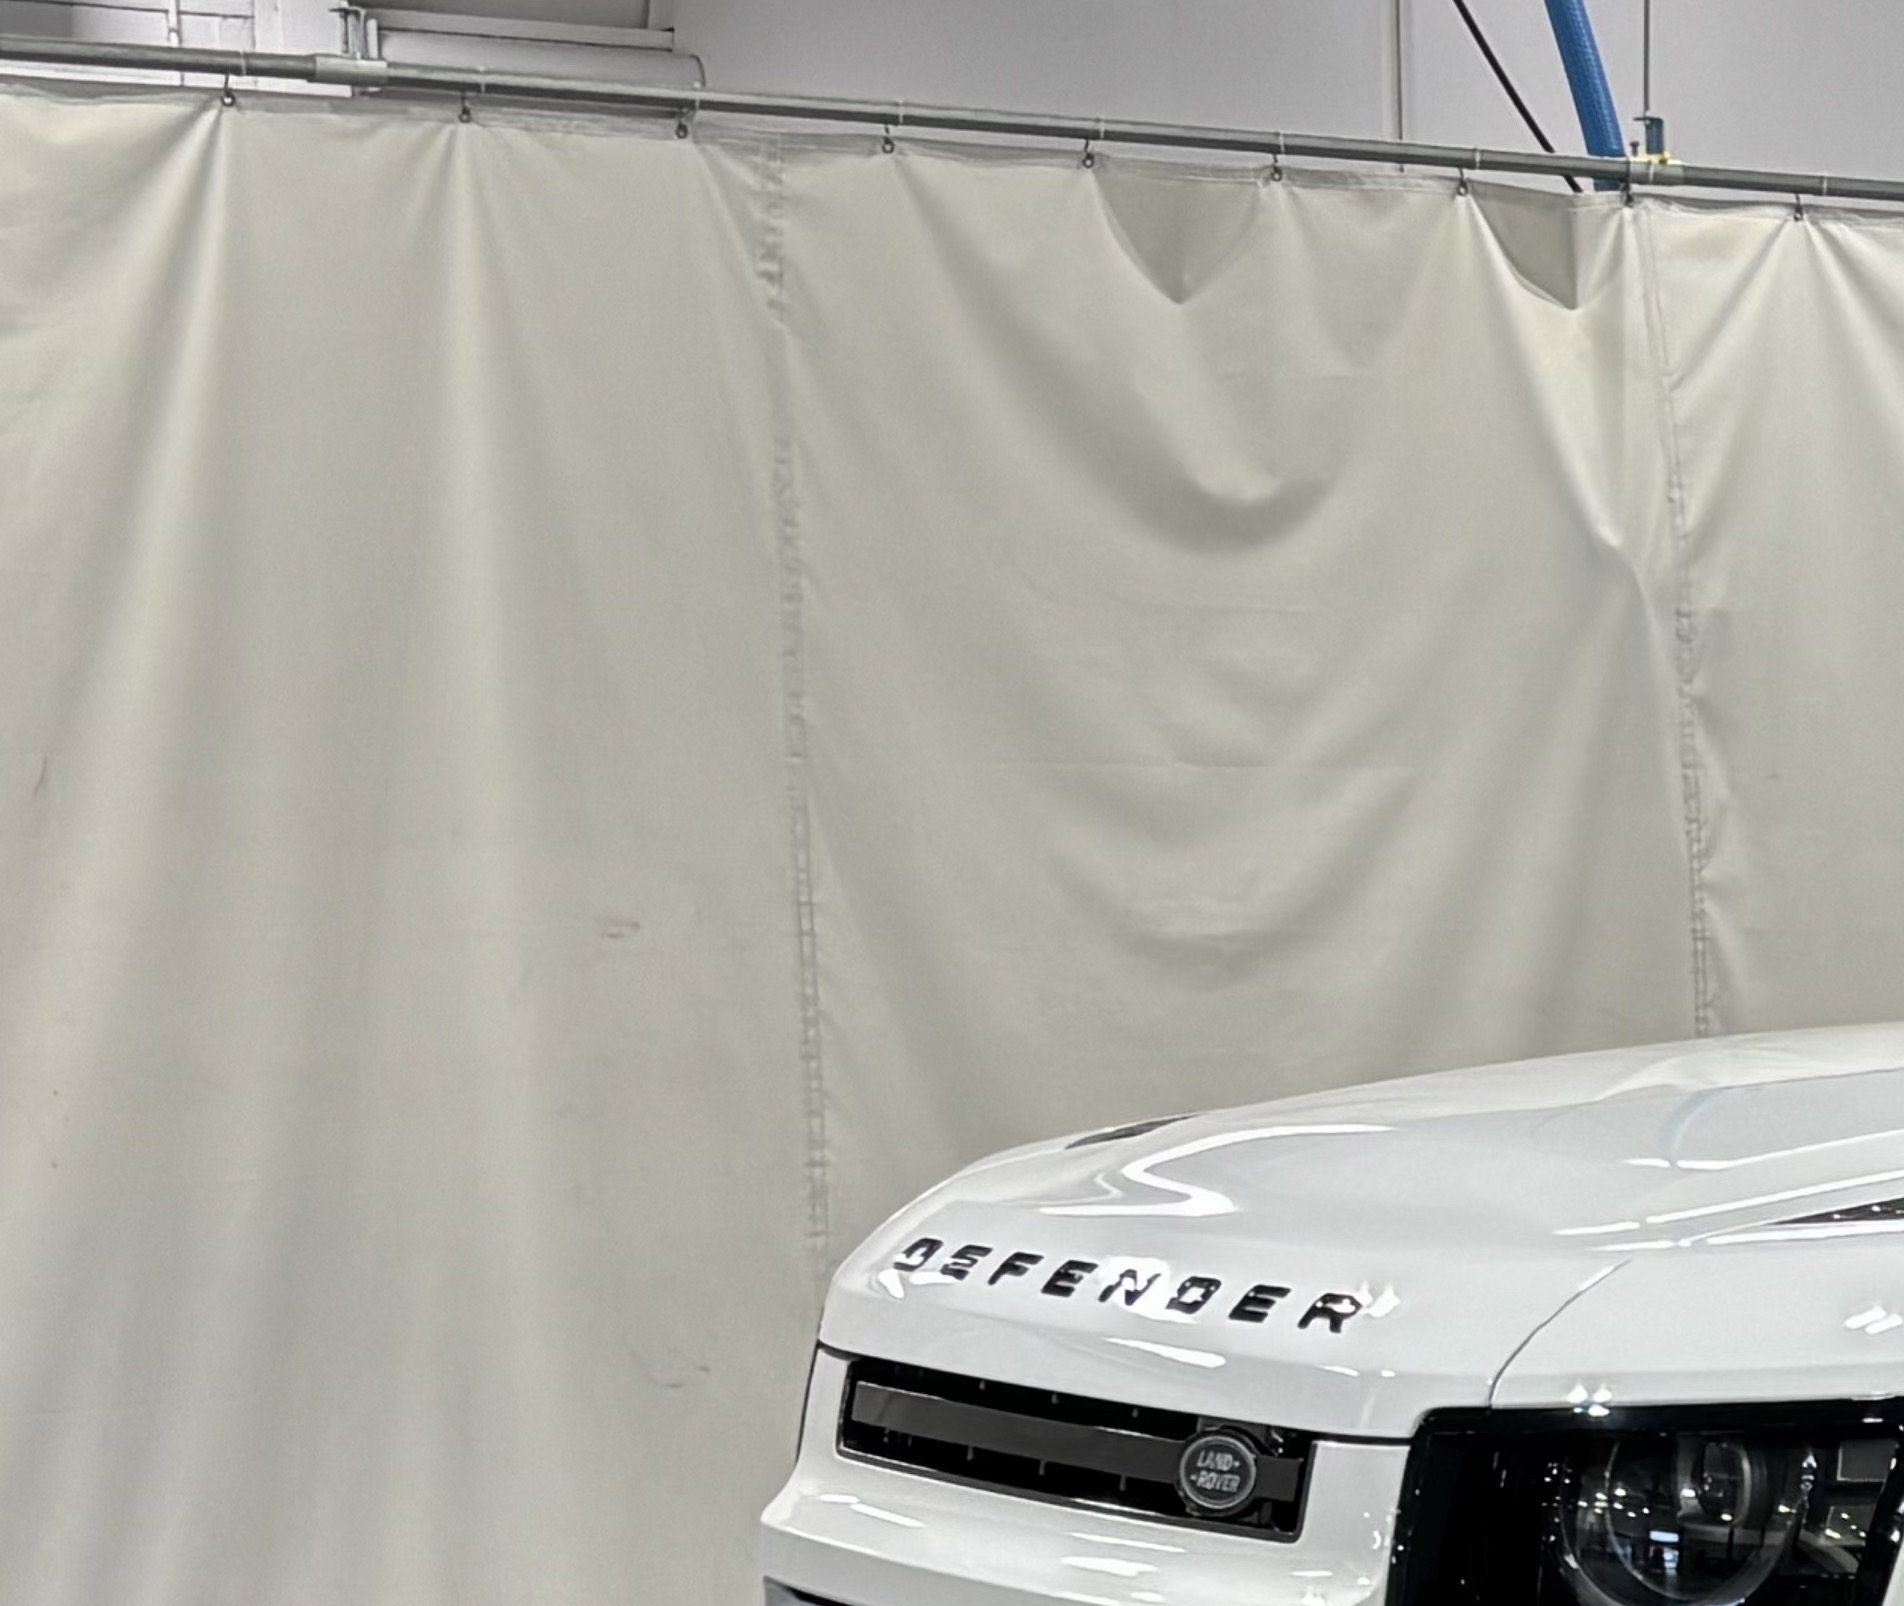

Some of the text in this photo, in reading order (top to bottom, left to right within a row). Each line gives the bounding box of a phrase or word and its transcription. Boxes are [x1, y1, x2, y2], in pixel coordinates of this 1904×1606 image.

[892, 1237, 1364, 1334] DEFENDER
[1196, 1451, 1234, 1472] LAND
[1196, 1469, 1242, 1493] ROVER
